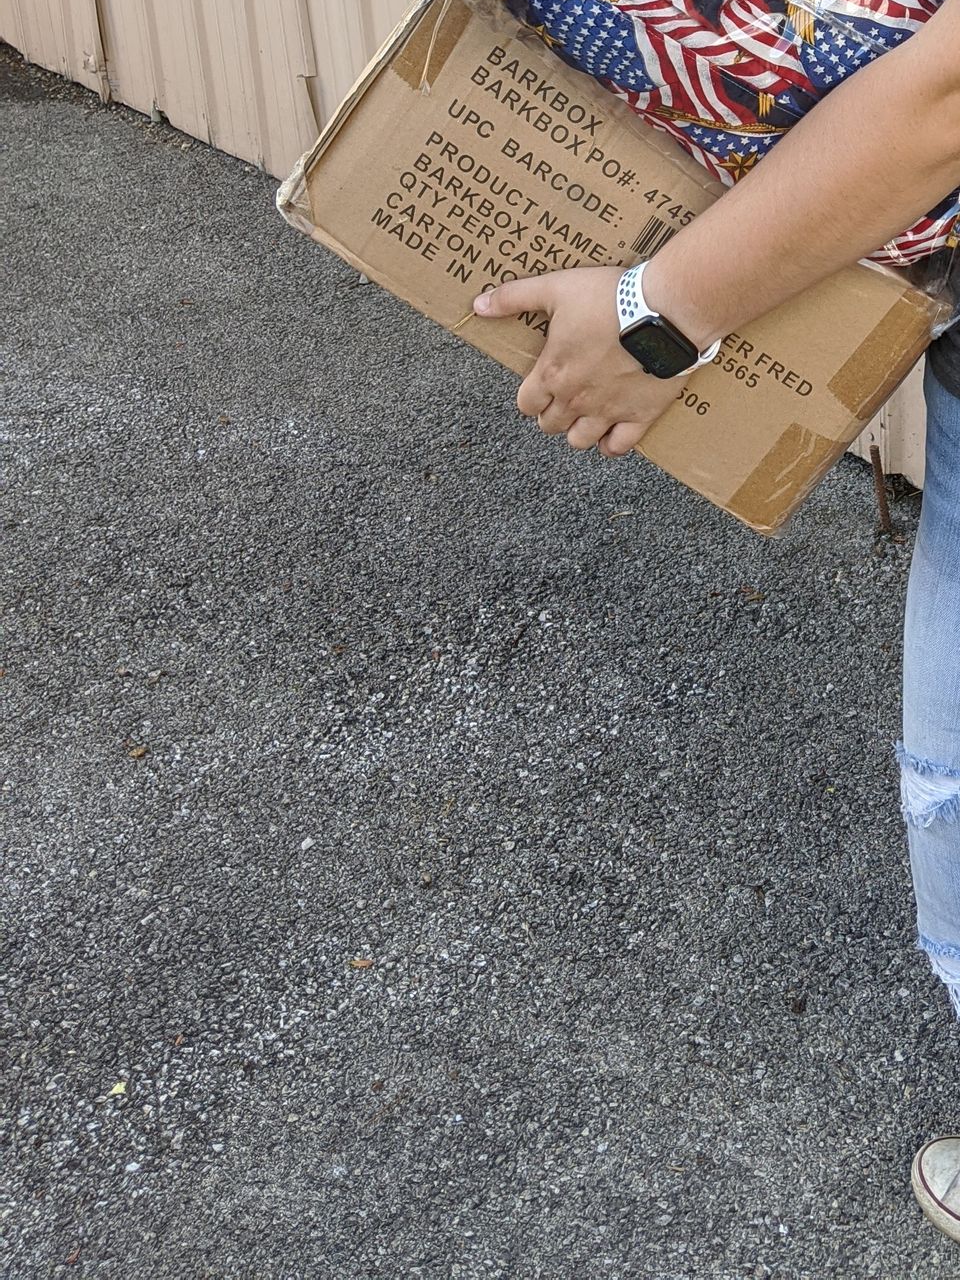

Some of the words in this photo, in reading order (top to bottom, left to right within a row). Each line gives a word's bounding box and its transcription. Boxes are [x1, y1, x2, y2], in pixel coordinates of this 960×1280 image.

[486, 45, 603, 136] BARKBOX
[448, 98, 495, 138] UPC
[501, 137, 623, 228] BARCODE:
[470, 65, 587, 156] BARKBOX
[584, 147, 640, 193] PO#:
[643, 189, 697, 226] 4745
[386, 192, 482, 264] CARTON
[400, 171, 448, 209] QTY
[446, 203, 496, 245] PER
[498, 239, 558, 275] CAR
[413, 153, 529, 241] BARKBOX
[370, 208, 441, 262] MADE
[446, 258, 473, 284] IN
[425, 130, 539, 215] PRODUCT
[537, 210, 612, 266] NAME:
[754, 352, 813, 397] FRED
[617, 240, 626, 249] 8
